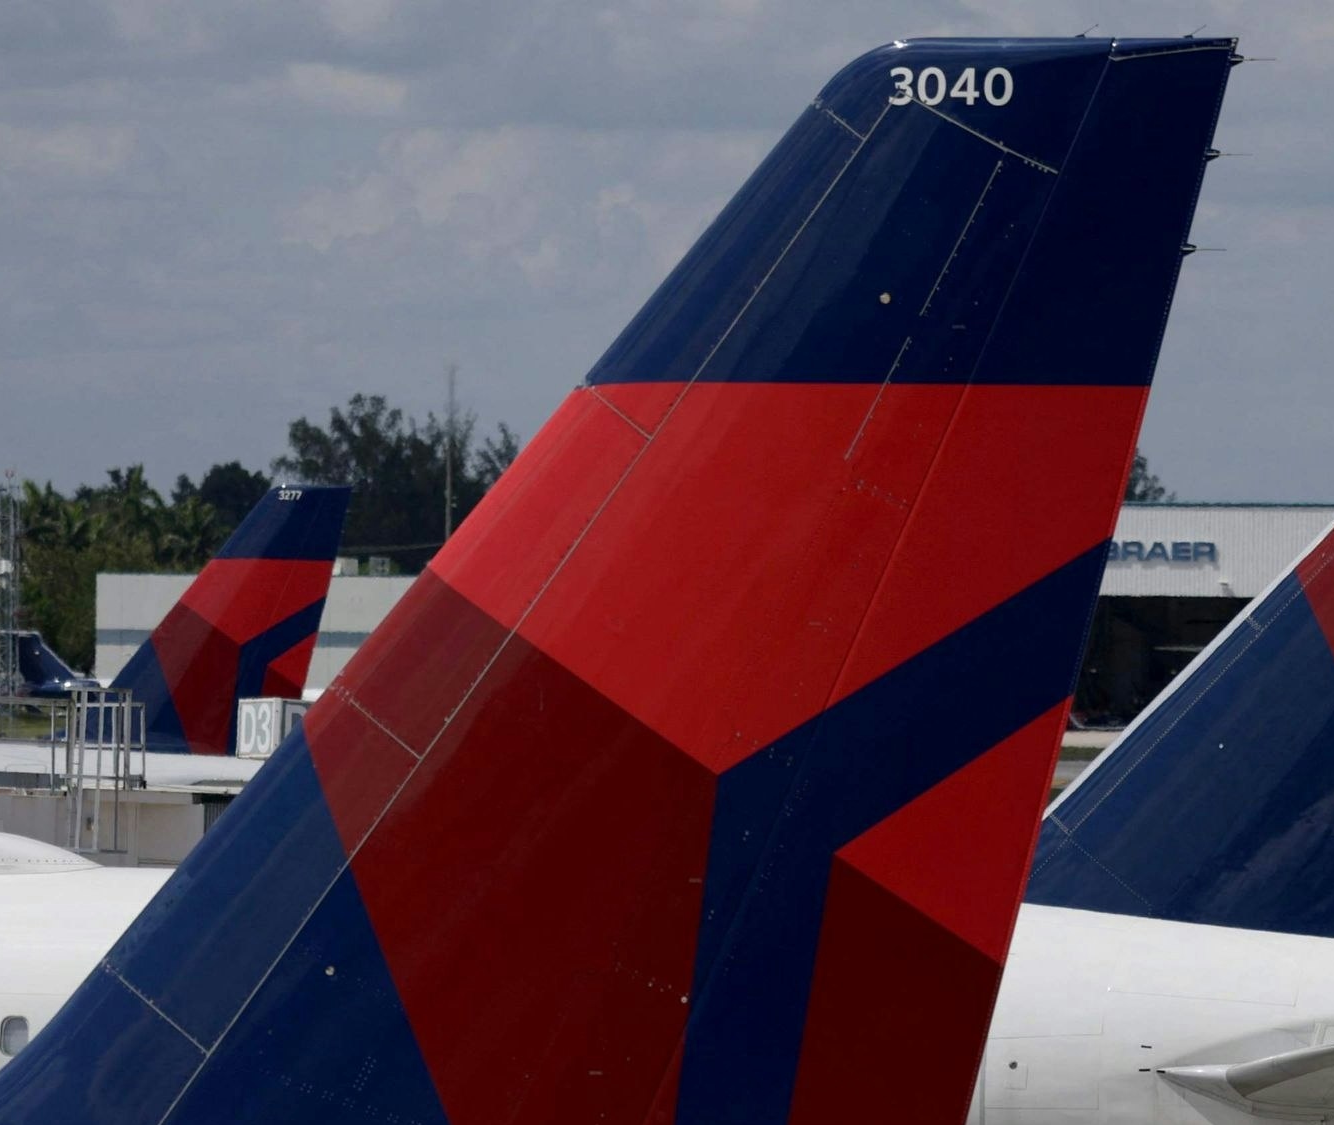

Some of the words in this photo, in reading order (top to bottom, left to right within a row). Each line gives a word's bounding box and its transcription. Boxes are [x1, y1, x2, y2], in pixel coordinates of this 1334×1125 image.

[889, 66, 1014, 106] 3040
[278, 490, 302, 501] 3277
[240, 703, 271, 753] D3
